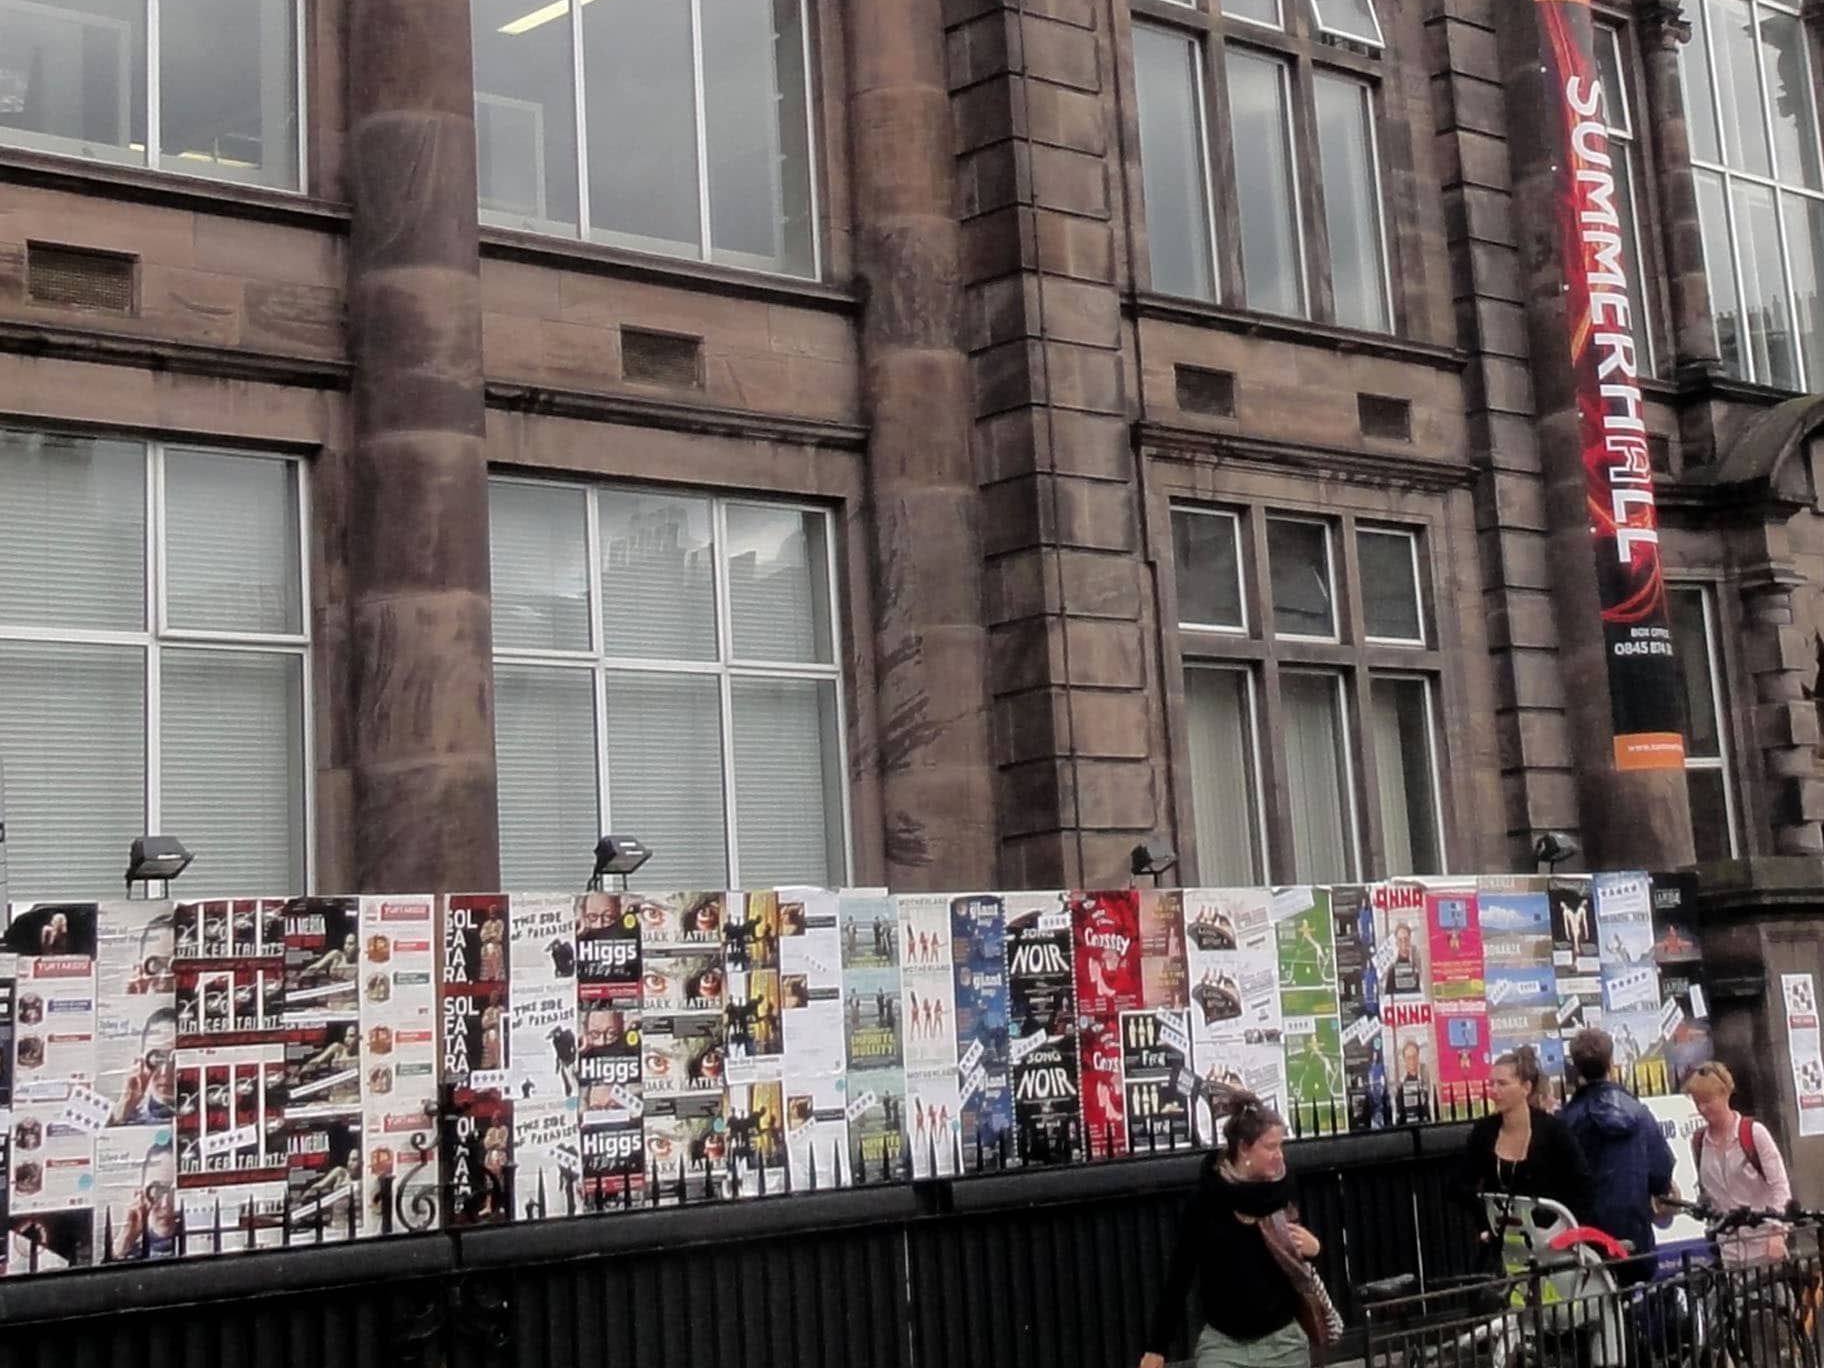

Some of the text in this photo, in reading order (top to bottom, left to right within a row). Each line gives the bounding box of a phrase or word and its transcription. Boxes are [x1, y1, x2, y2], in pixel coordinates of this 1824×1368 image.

[1566, 74, 1659, 564] SUMMERHALL
[1631, 627, 1649, 638] BOX
[1614, 641, 1649, 656] 0845
[1376, 887, 1423, 909] ANNA
[445, 909, 478, 930] SOL
[539, 912, 562, 925] SIDE
[444, 947, 467, 967] TA
[578, 940, 638, 966] Higgs
[1010, 943, 1070, 975] NOIR
[443, 996, 480, 1016] SOL
[540, 998, 563, 1012] SIDE
[1384, 1003, 1433, 1027] ANNA
[443, 1016, 468, 1035] FA
[443, 1035, 468, 1054] TA
[1026, 1050, 1063, 1064] SONG
[580, 1057, 639, 1083] Higgs
[1016, 1067, 1077, 1100] NOIR
[543, 1115, 567, 1129] SIDE
[583, 1132, 642, 1158] Higgs
